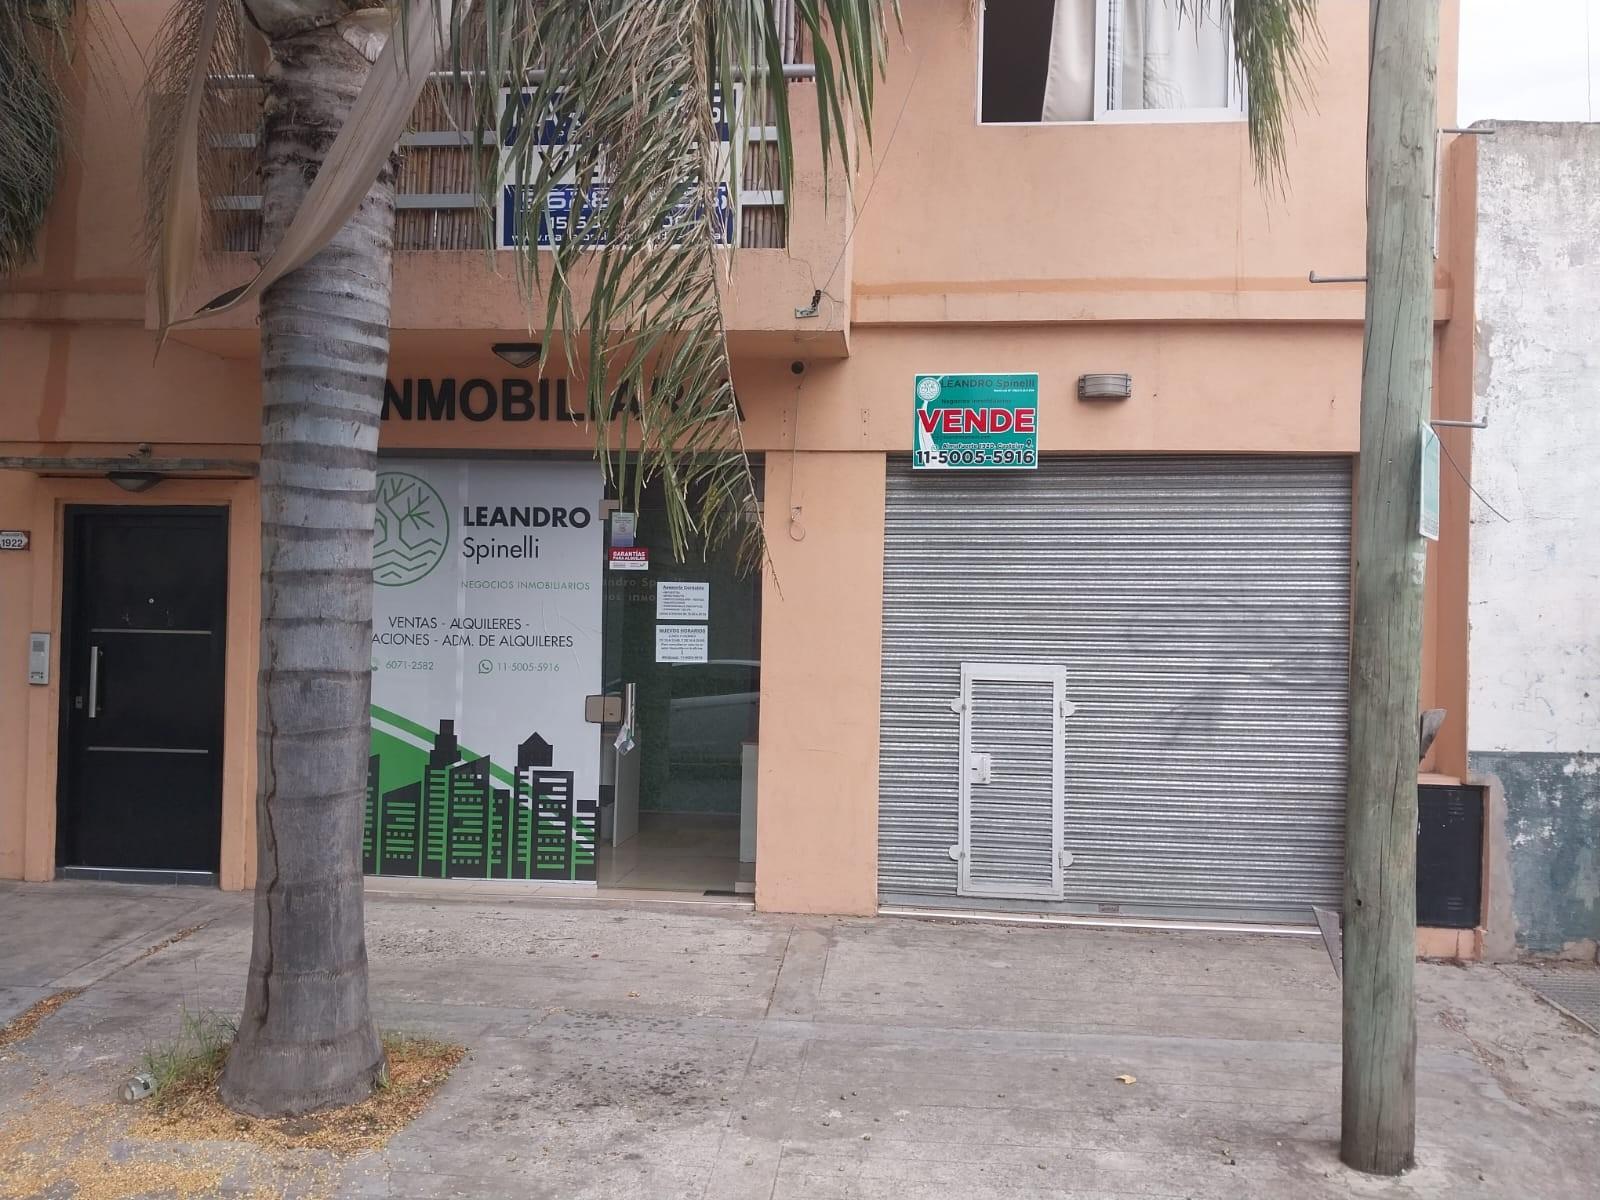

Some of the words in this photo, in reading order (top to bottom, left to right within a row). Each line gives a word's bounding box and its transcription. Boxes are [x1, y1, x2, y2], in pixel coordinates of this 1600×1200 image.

[939, 378, 993, 388] LEANDRO
[996, 378, 1035, 389] Spinelli
[917, 407, 1036, 434] VENDE
[916, 449, 1035, 464] 11-5005-5916
[463, 506, 591, 528] LEANDRO
[2, 538, 23, 547] 1922
[462, 535, 540, 564] Spinelli
[461, 580, 514, 590] NEGOCIOS
[517, 581, 590, 591] INMOBILIARIOS
[388, 616, 437, 629] VENTAS
[450, 618, 522, 630] ALQUILERES
[372, 633, 430, 646] ACIONES
[442, 635, 474, 647] ADM.
[479, 636, 495, 647] DE
[499, 636, 574, 648] ALQUILERES
[498, 663, 560, 672] 11-5005-5916
